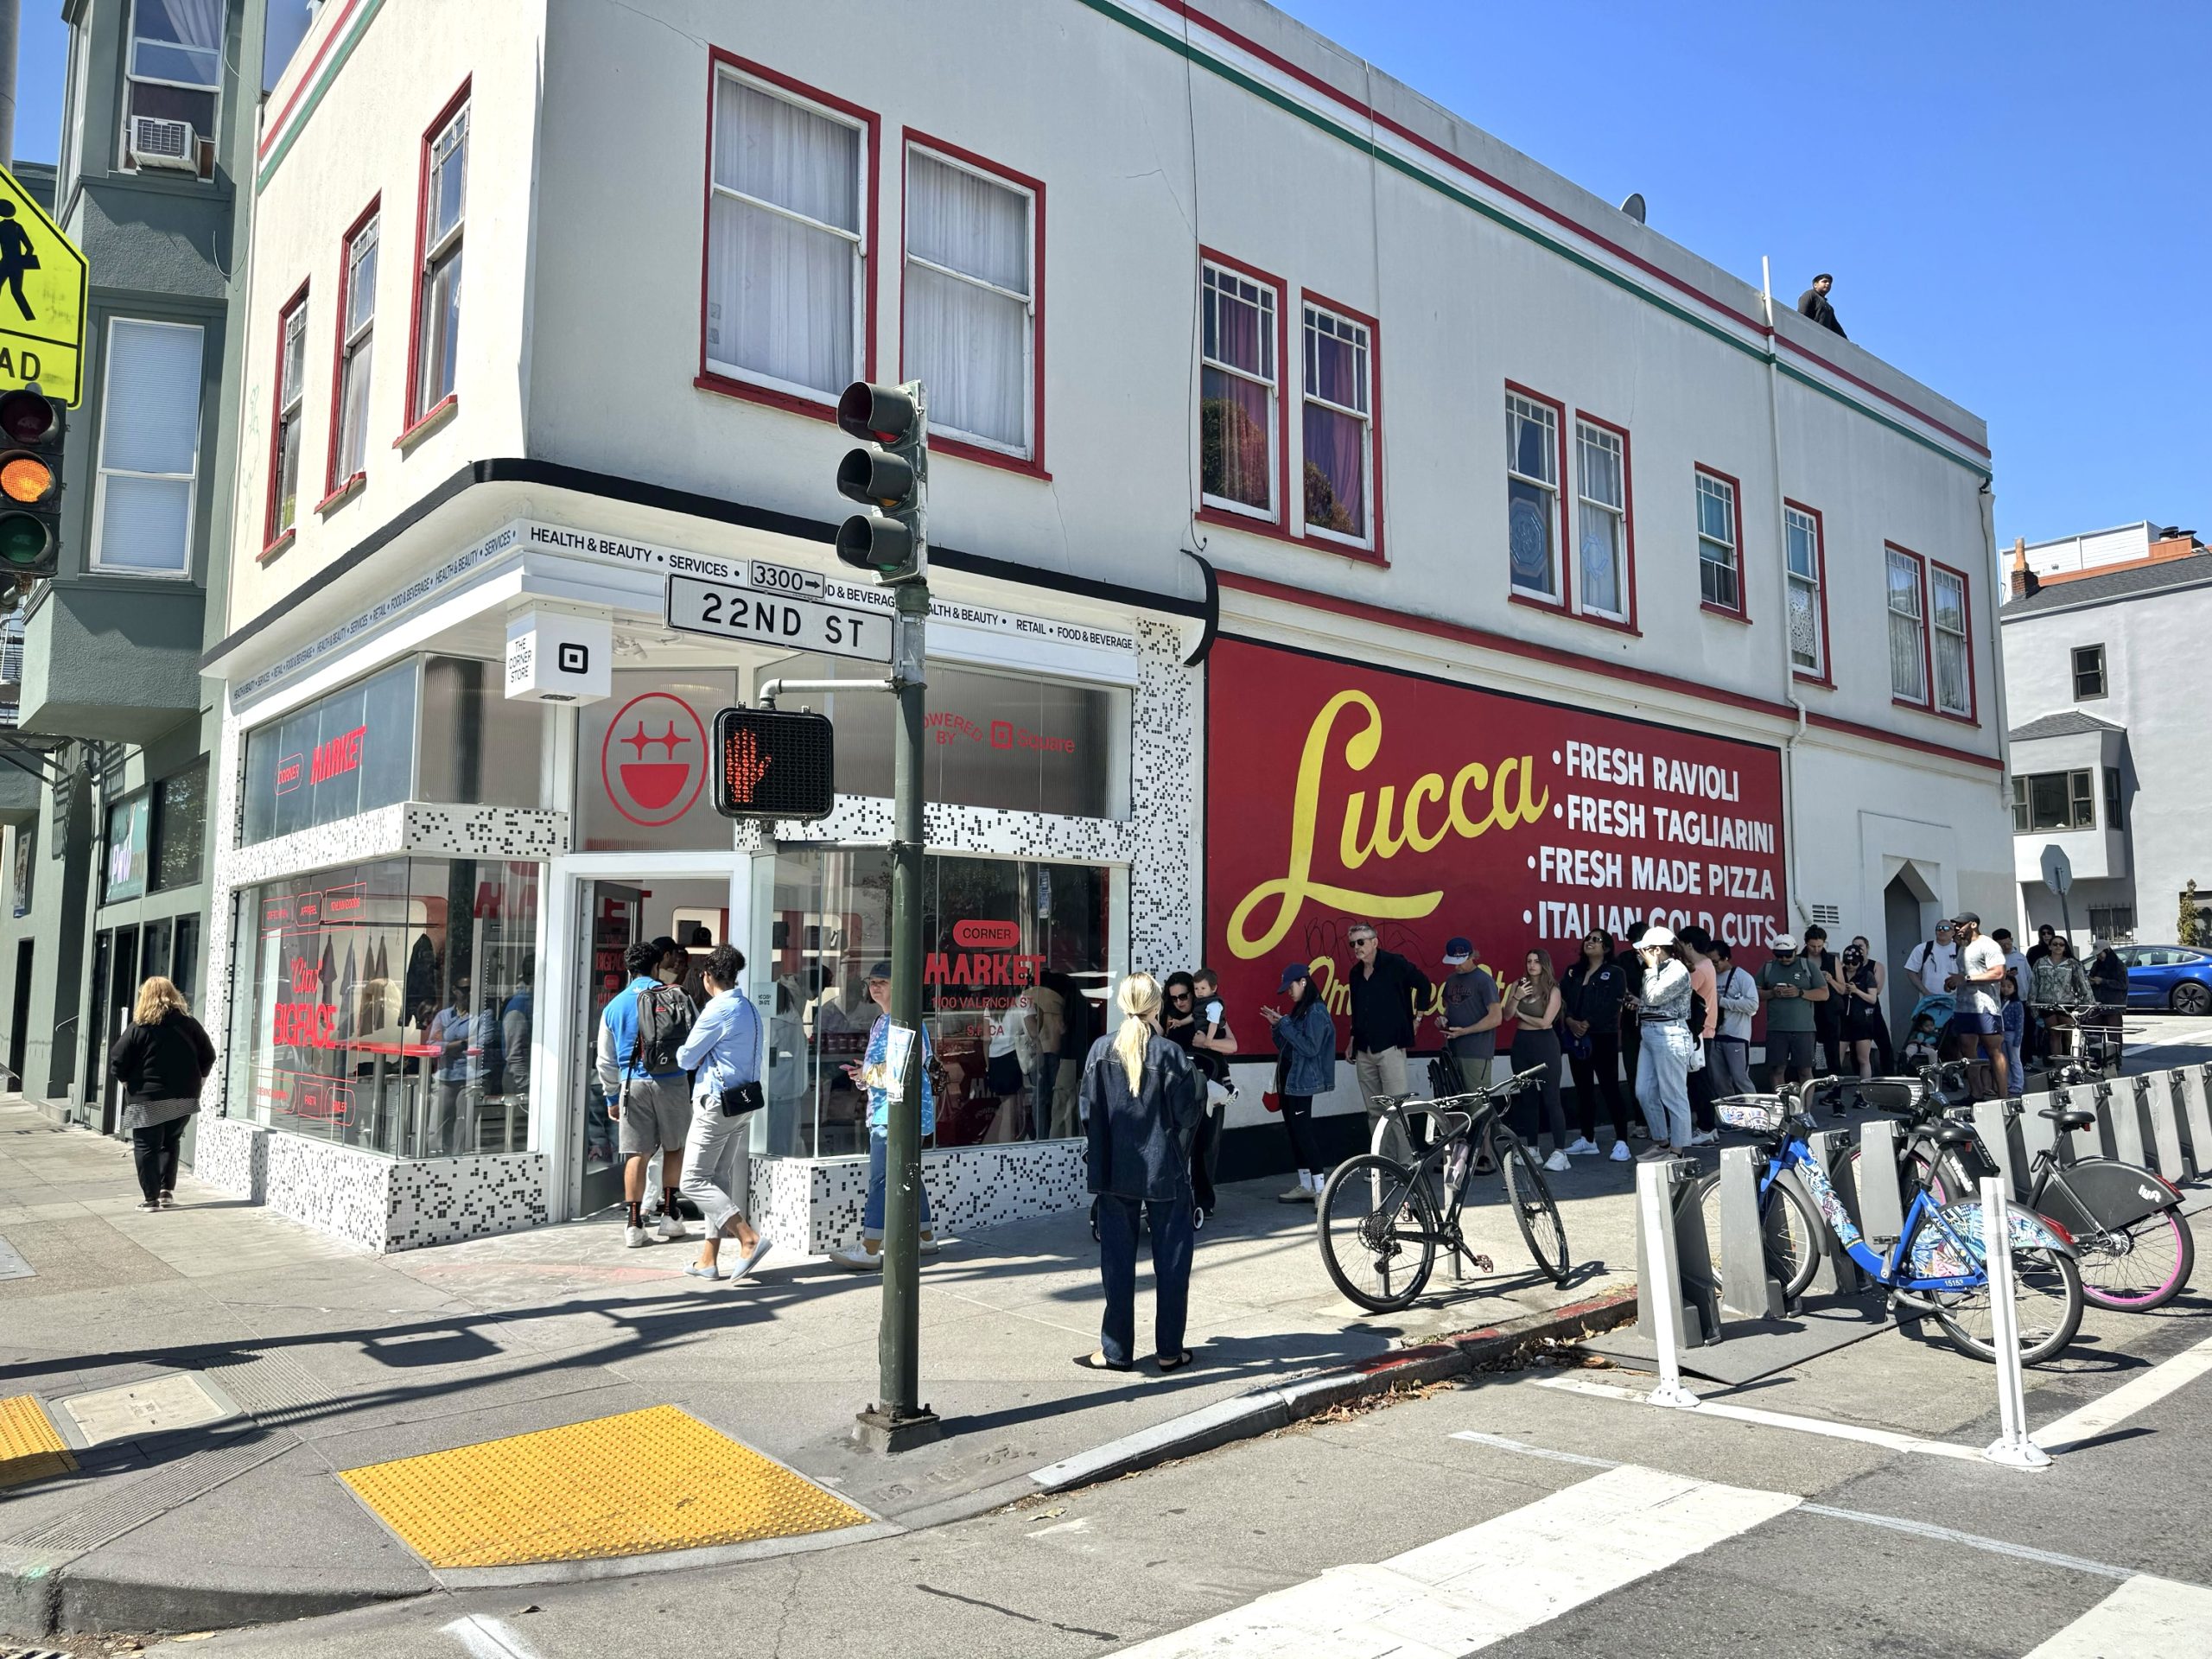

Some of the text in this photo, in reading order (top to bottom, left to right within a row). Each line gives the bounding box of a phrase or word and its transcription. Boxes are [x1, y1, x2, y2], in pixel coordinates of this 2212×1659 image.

[435, 562, 454, 585] HEALTH
[458, 548, 479, 571] BEAUTY
[484, 530, 512, 557] SERVICES
[531, 527, 728, 577] HEALTH & BEAUTY SERVICES
[754, 565, 803, 591] 3300
[837, 587, 846, 599] &
[847, 589, 895, 608] BEVERAG
[702, 592, 864, 648] 22ND ST
[952, 607, 960, 619] &
[962, 608, 998, 626] BEAUTY
[1016, 620, 1046, 635] RETAIL
[1057, 626, 1081, 641] FOOD
[1082, 632, 1089, 642] &
[1090, 633, 1133, 649] BEVERAGE
[509, 650, 531, 670] CORNER
[515, 638, 526, 652] THE
[510, 665, 529, 683] STORE
[936, 729, 957, 746] BY
[1017, 728, 1076, 753] Square
[310, 724, 367, 785] MARKET
[277, 764, 300, 785] CORNER
[1566, 740, 1739, 803] FRESH RAVIOLI
[1226, 690, 1548, 959] Lucca
[1567, 794, 1775, 855] FRESH TAGLIARINI
[1540, 846, 1776, 900] FRESH MADE PIZZA
[963, 927, 1011, 940] CORNER
[1721, 912, 1778, 950] CUTS
[924, 953, 1046, 986] MARKET
[959, 996, 1017, 1009] VALENCIA
[272, 1002, 339, 1050] BIGFACE
[989, 1025, 1005, 1036] CA
